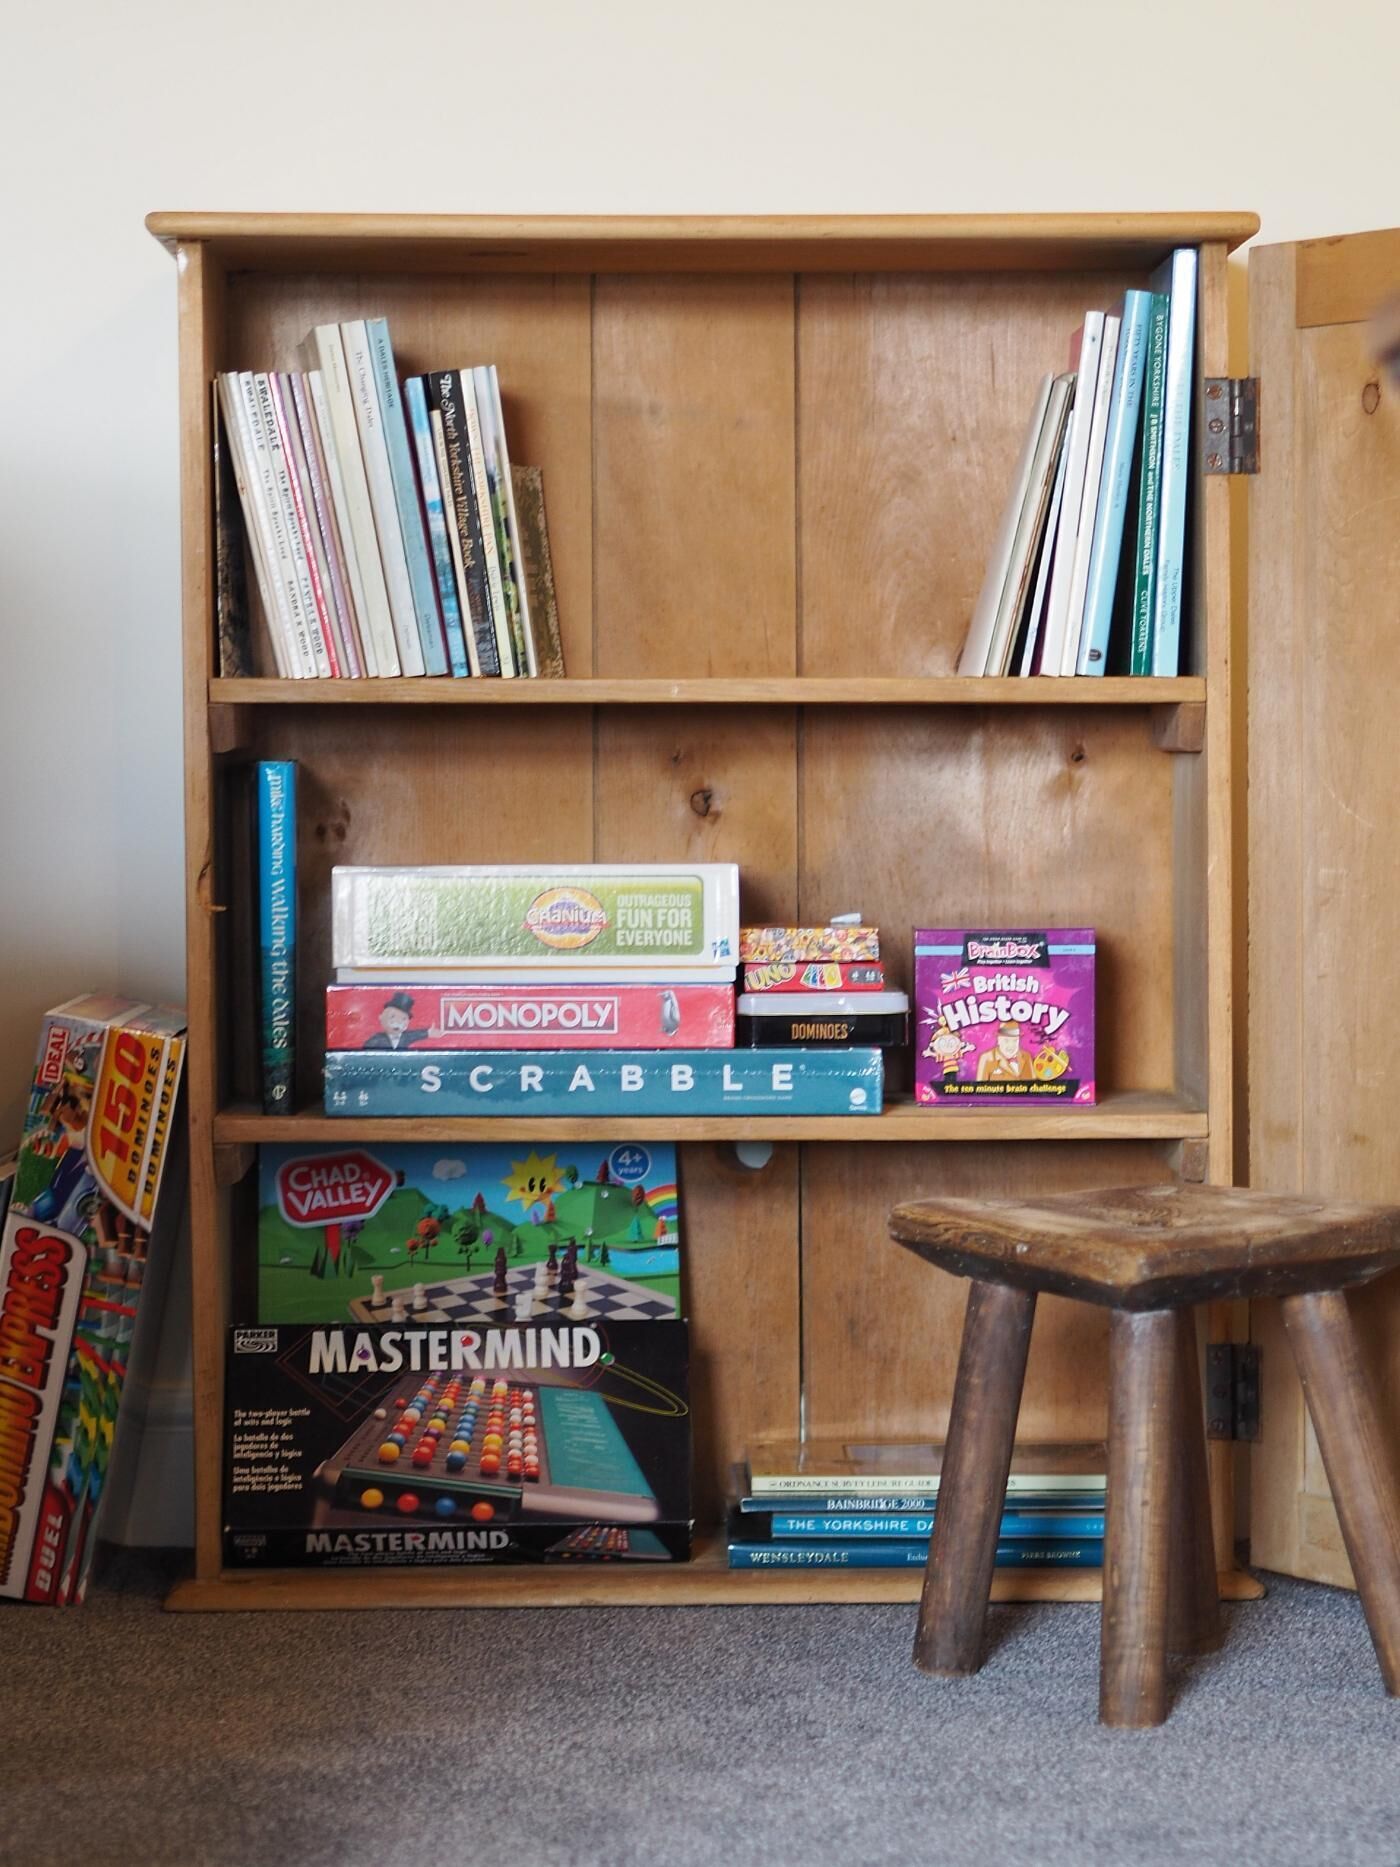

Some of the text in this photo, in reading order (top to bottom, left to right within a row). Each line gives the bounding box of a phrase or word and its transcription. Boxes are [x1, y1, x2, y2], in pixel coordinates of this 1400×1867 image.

[1131, 350, 1140, 376] YEARS
[1151, 314, 1165, 407] BYGONE YORKSHIRE
[257, 380, 280, 450] SWALEDALE
[1148, 425, 1158, 470] SMITHSON
[439, 373, 476, 570] The North Yorkshire Village Book
[1146, 485, 1154, 502] THE
[1143, 502, 1153, 549] NORTHERN
[1142, 549, 1151, 576] DALES
[1137, 590, 1149, 653] CLIVE TORRENS
[617, 893, 693, 908] OUTRAGEOUS
[616, 908, 693, 929] FUN FOR
[616, 929, 693, 947] EVERYONE
[967, 941, 1042, 960] BrainBox
[271, 960, 289, 995] the
[744, 963, 796, 990] UNO
[972, 973, 1039, 994] British
[447, 1002, 612, 1029] MONOPOLY
[942, 995, 1071, 1035] History
[791, 1023, 848, 1040] DOMINOES
[44, 1030, 67, 1080] IDEAL
[420, 1064, 794, 1093] SCRABBLE
[944, 1083, 1066, 1095] The ten minute brain challenge
[100, 1032, 147, 1163] 150
[128, 1047, 160, 1183] DOMINOES
[145, 1058, 176, 1194] DOMINOES
[618, 1150, 642, 1166] 4+
[618, 1167, 643, 1176] years
[288, 1163, 361, 1191] CHAD
[287, 1178, 383, 1216] VALLEY
[0, 1227, 73, 1391] EXPRESS
[309, 1327, 601, 1374] MASTERMIND
[234, 1409, 247, 1417] The
[270, 1432, 279, 1440] de
[779, 1480, 829, 1488] ORDNANCE
[826, 1499, 925, 1511] BAINBRIDGE 2000
[787, 1519, 816, 1531] THE
[823, 1519, 909, 1531] YORKSHIRE
[34, 1514, 63, 1592] DUEL
[306, 1531, 510, 1553] MASTERMIND
[751, 1552, 849, 1564] WENSLEYDALE
